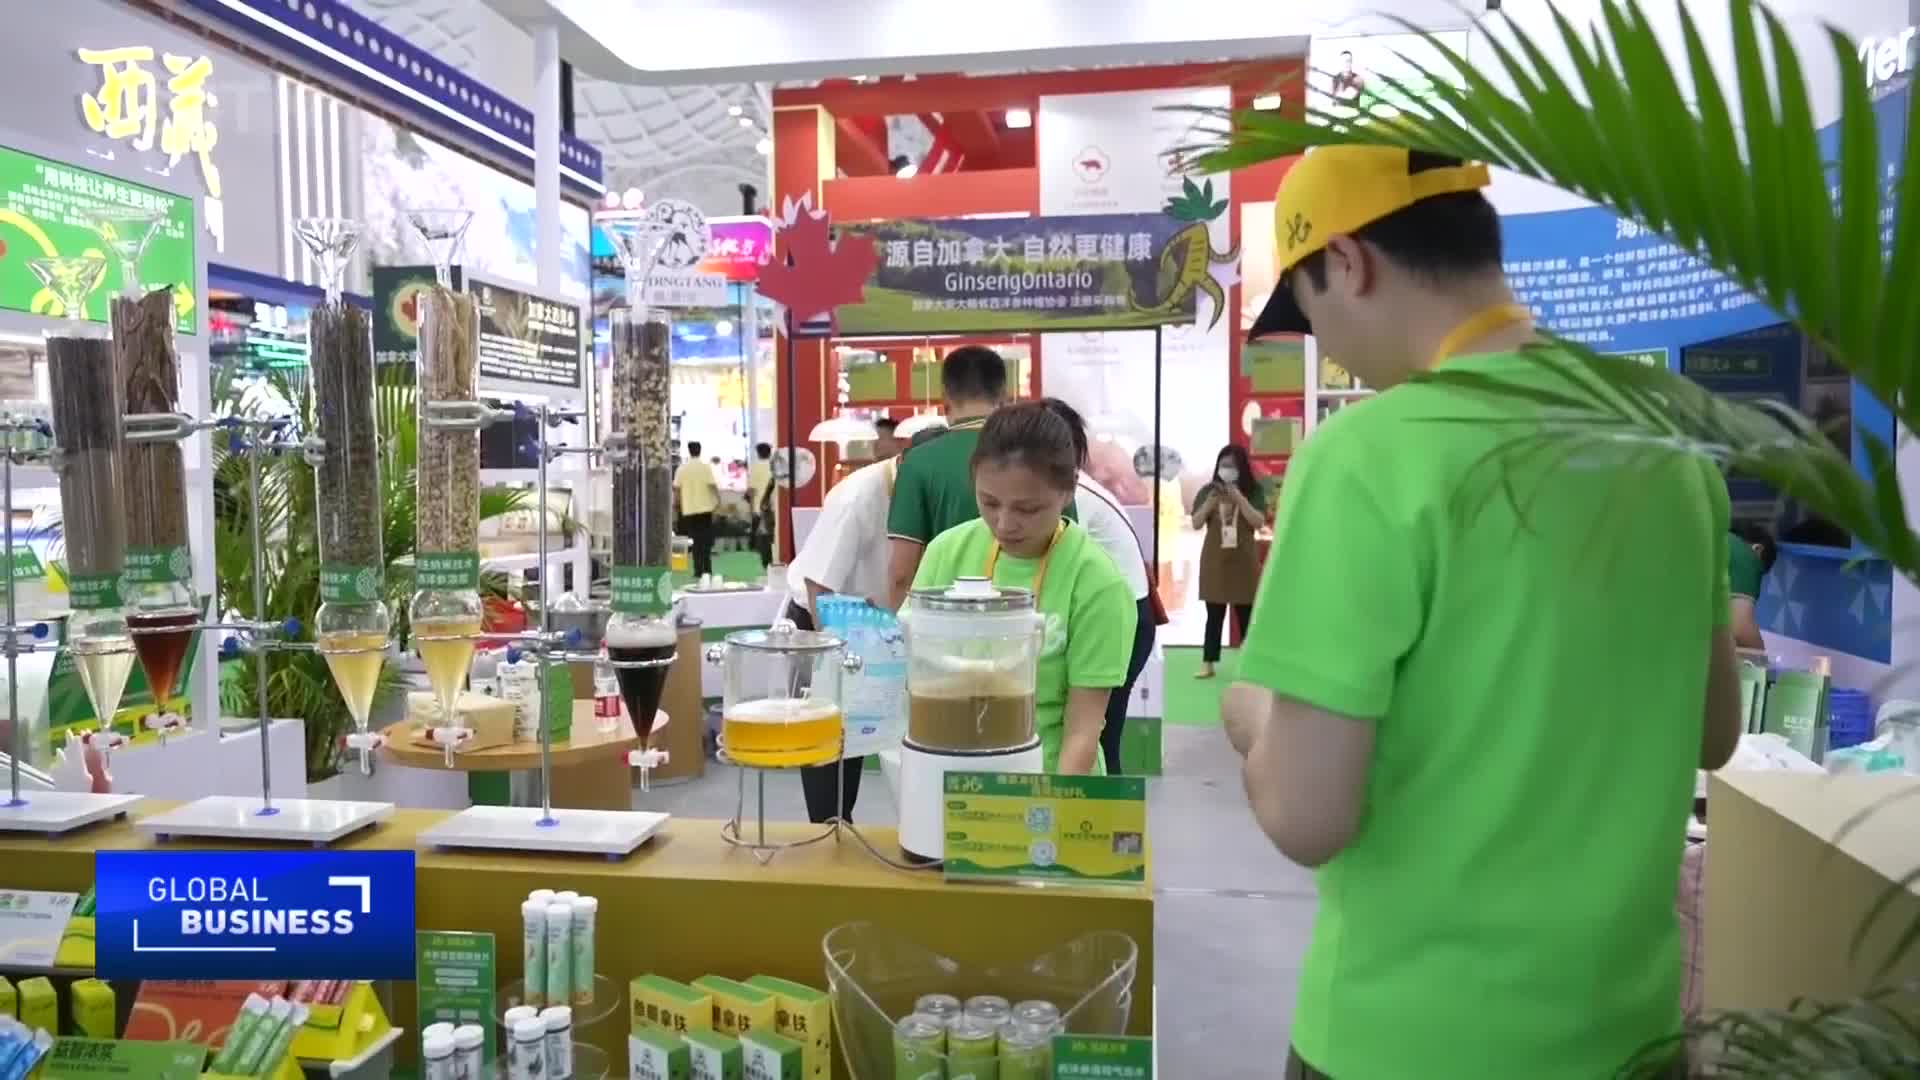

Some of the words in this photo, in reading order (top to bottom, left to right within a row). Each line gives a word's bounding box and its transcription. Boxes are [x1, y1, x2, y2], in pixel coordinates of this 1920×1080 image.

[886, 238, 1012, 267] 源自加拿大
[1023, 232, 1152, 262] 自然更健康
[945, 271, 1093, 295] GinsengOntario
